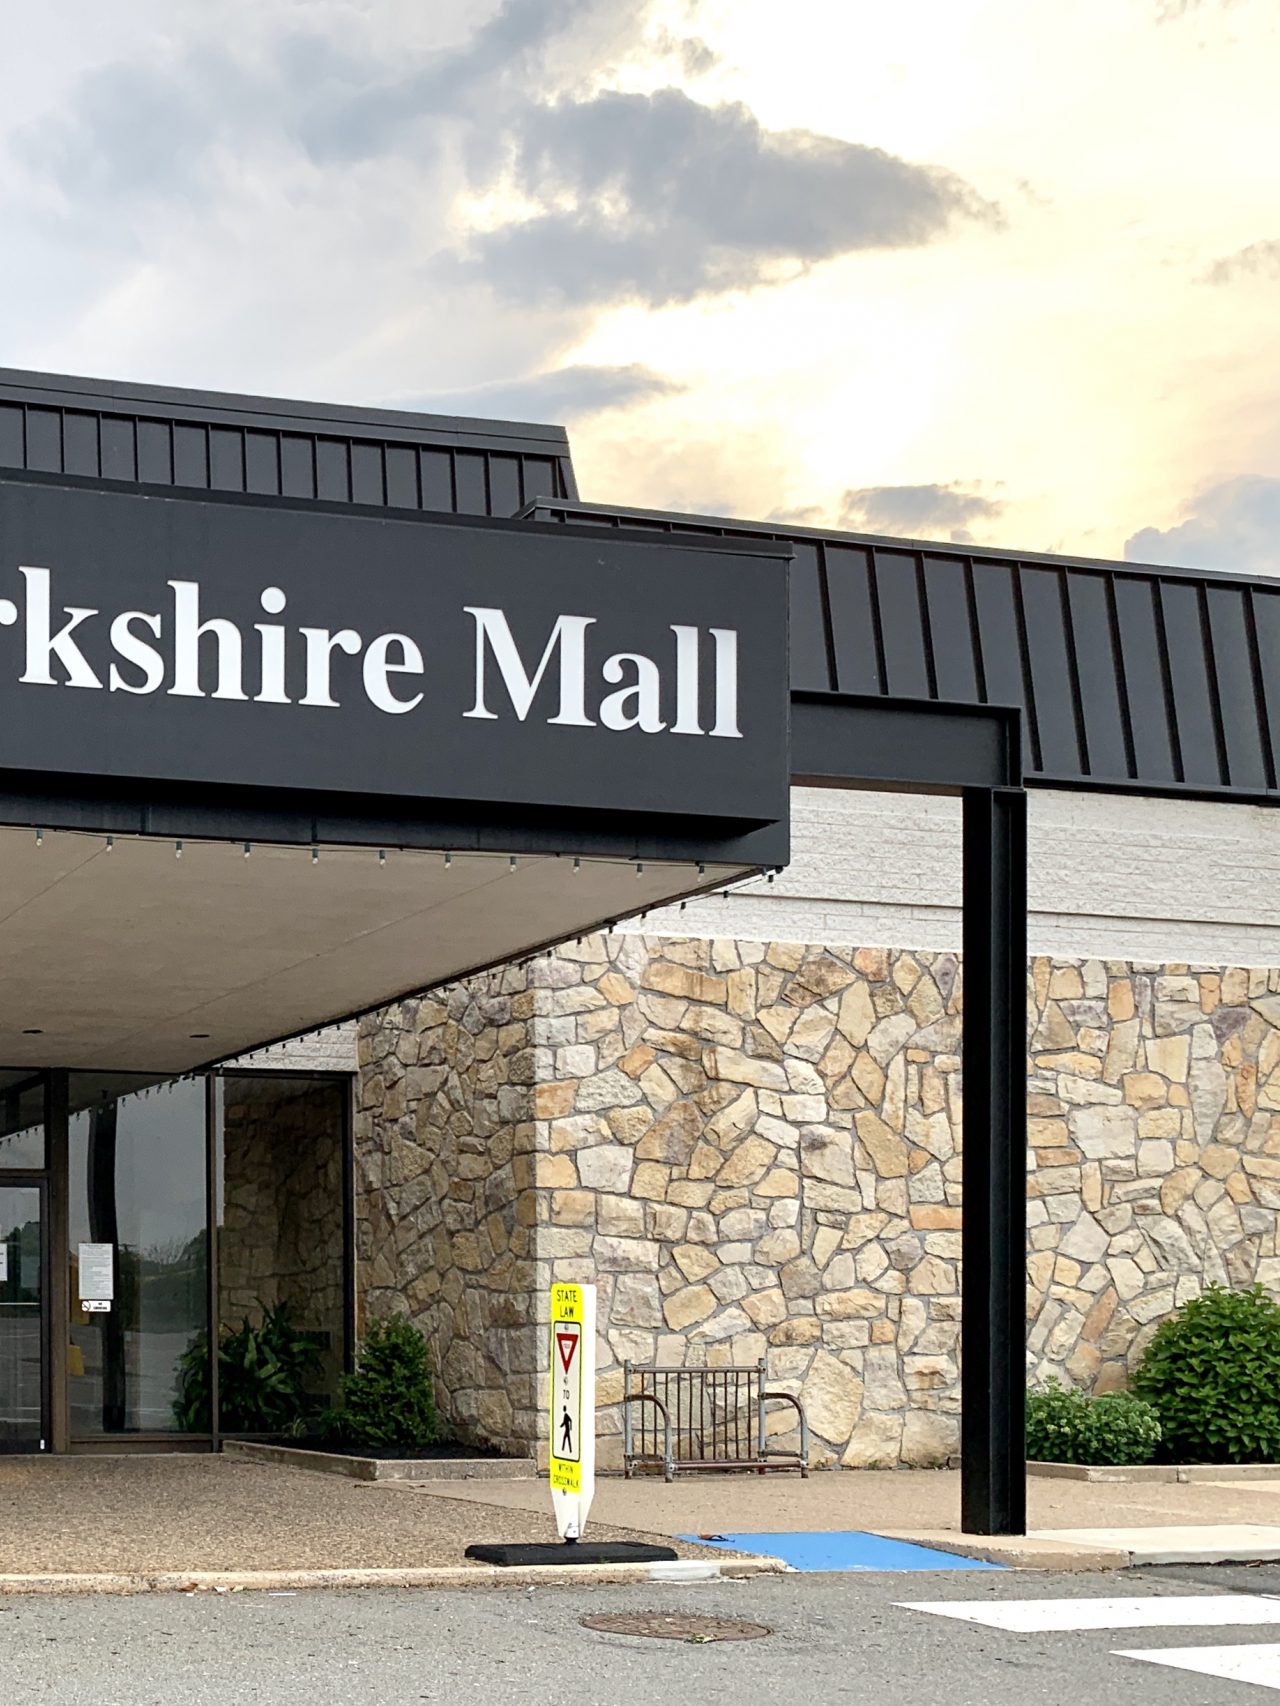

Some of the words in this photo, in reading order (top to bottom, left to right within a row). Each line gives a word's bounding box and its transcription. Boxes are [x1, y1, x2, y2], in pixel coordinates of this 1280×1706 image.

[462, 606, 744, 738] Mall
[556, 1289, 578, 1303] STATE
[559, 1306, 575, 1318] LAW
[562, 1389, 571, 1401] TO
